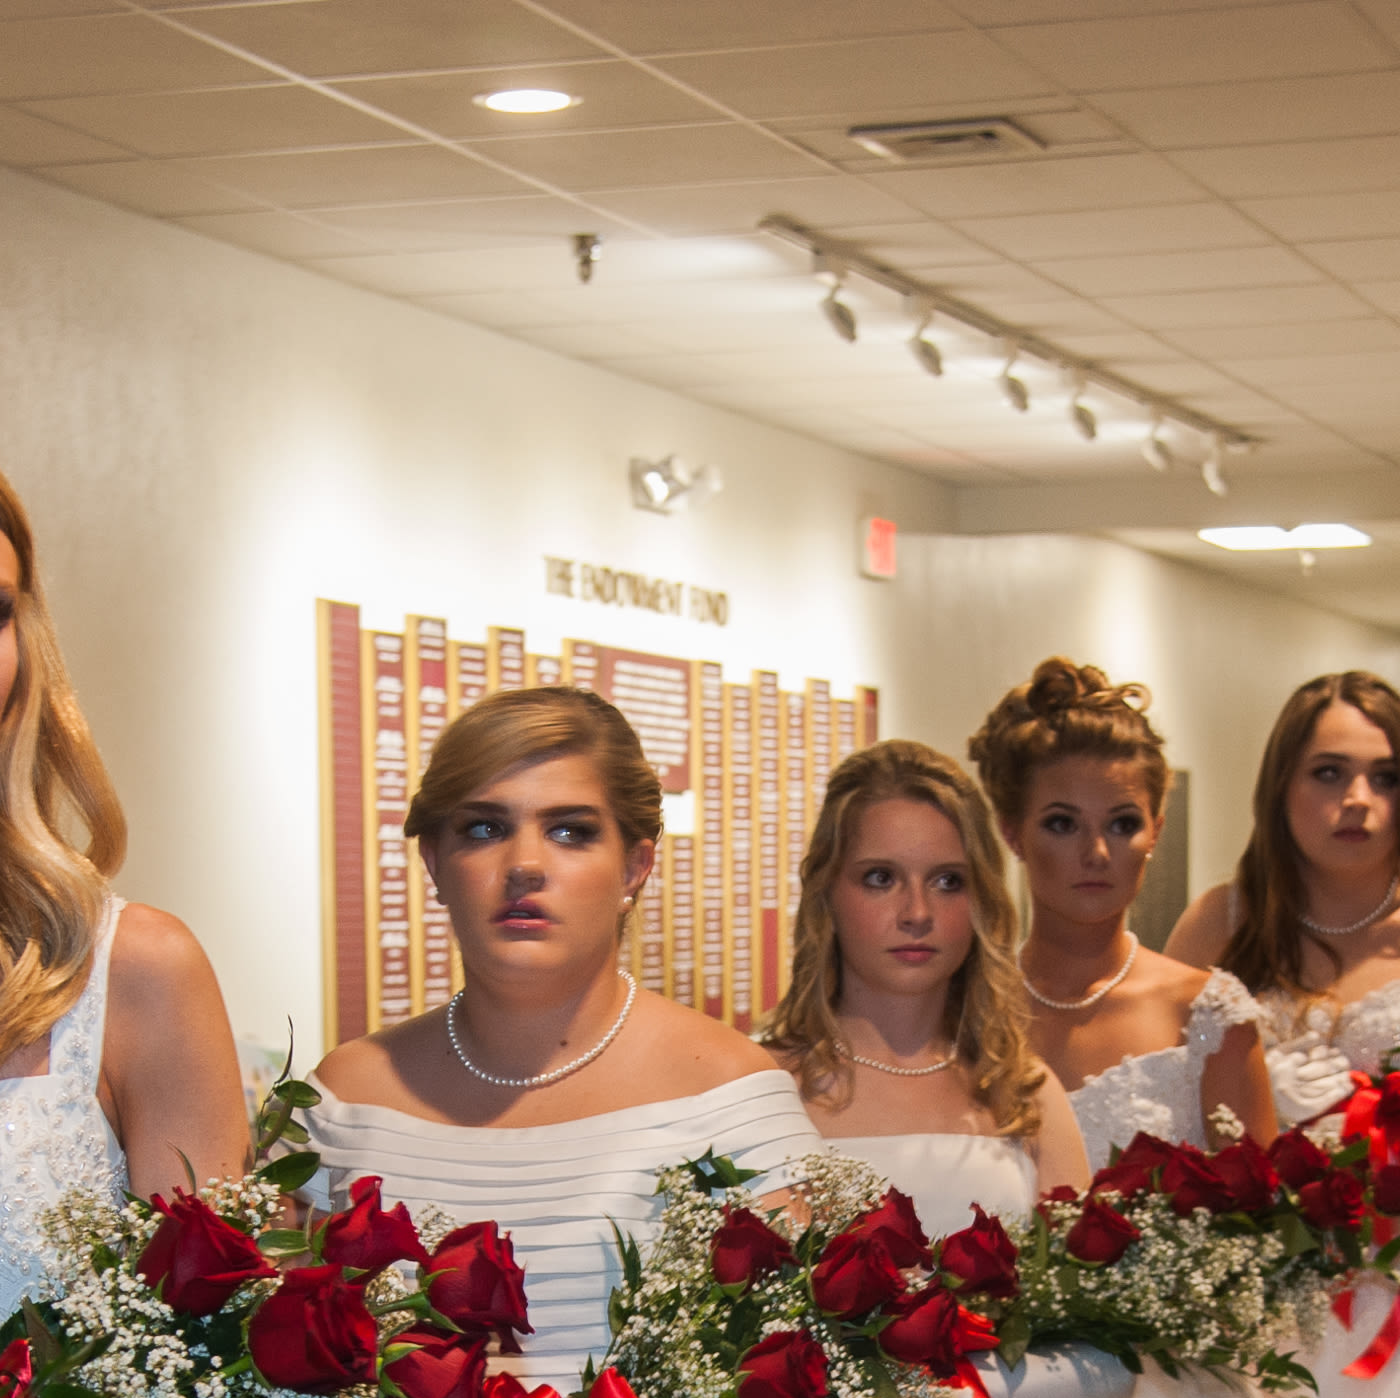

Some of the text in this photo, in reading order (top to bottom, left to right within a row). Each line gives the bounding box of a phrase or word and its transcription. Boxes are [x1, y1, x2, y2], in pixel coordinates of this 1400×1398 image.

[542, 555, 729, 627] THE ENDOWMENT FUND
